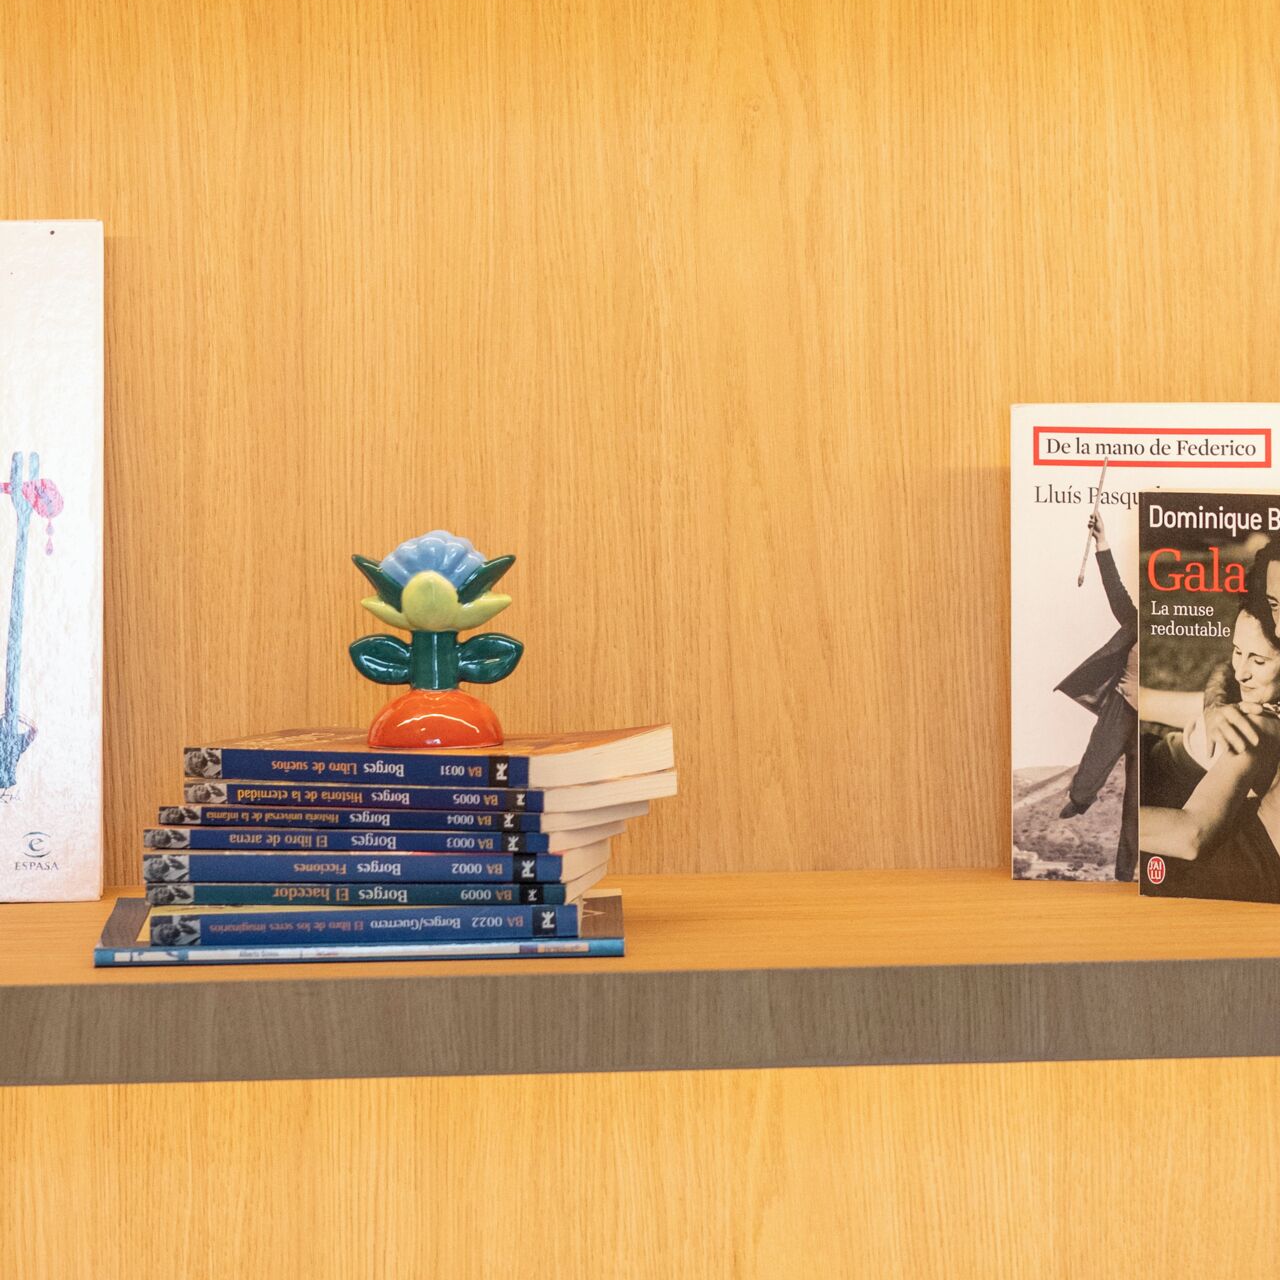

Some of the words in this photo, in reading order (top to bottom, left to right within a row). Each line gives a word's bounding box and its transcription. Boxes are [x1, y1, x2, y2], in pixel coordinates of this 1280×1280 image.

[1046, 437, 1072, 455] De
[1075, 436, 1091, 456] la
[1095, 441, 1146, 457] mano
[1149, 437, 1172, 457] de
[1176, 438, 1257, 458] Federico
[1034, 483, 1082, 505] Lluís
[1149, 504, 1264, 538] Dominique
[1147, 546, 1249, 594] Gala
[1150, 600, 1170, 617] La
[1173, 604, 1215, 618] muse
[1150, 619, 1231, 638] redoutable
[271, 760, 309, 773] sueños
[312, 760, 326, 771] de
[329, 762, 358, 775] Libro
[363, 760, 405, 777] Borges
[439, 765, 465, 776] 0031
[468, 765, 483, 777] BA
[236, 787, 289, 801] eternidad
[290, 789, 302, 801] la
[304, 789, 319, 802] de
[320, 790, 364, 803] Historia
[371, 789, 411, 805] Borges
[452, 793, 481, 805] 0005
[483, 794, 499, 806] BA
[250, 811, 263, 821] de
[350, 812, 391, 827] Borges
[446, 814, 474, 825] 0004
[477, 814, 492, 826] BA
[228, 833, 263, 844] arena
[265, 834, 281, 847] de
[284, 834, 312, 848] libro
[315, 834, 328, 848] El
[351, 832, 397, 849] Borges
[446, 837, 475, 848] 0003
[477, 837, 494, 849] BA
[15, 861, 60, 871] ESPASA
[293, 862, 347, 874] Ficciones
[356, 862, 402, 876] Borges
[451, 863, 482, 874] 0002
[487, 863, 504, 875] BA
[273, 886, 331, 901] hacedor
[335, 887, 350, 902] El
[358, 888, 408, 903] Borges
[460, 889, 492, 901] 0009
[496, 889, 513, 901] BA
[328, 920, 351, 931] libro
[353, 919, 364, 931] El
[370, 916, 461, 931] Borges/Guerrero
[471, 916, 503, 928] 0022
[506, 915, 524, 928] BA
